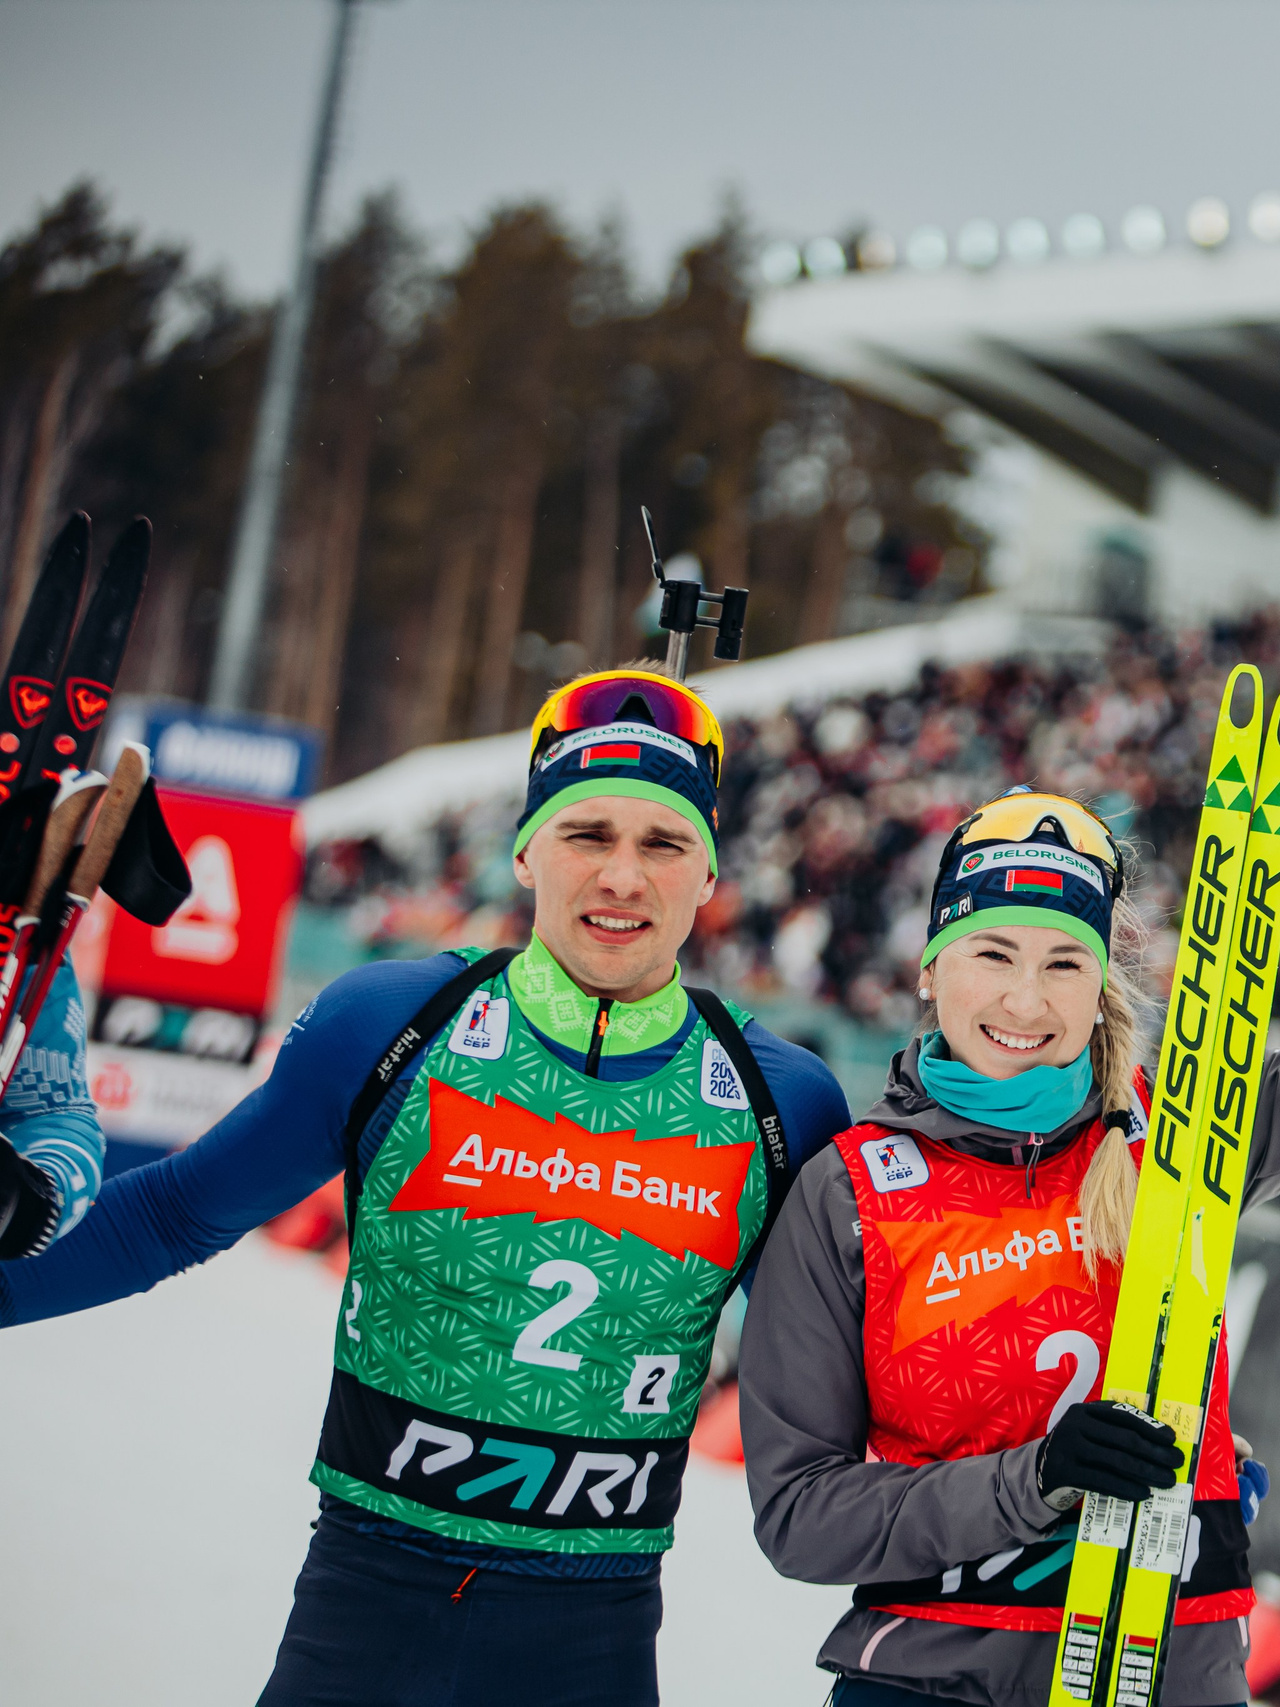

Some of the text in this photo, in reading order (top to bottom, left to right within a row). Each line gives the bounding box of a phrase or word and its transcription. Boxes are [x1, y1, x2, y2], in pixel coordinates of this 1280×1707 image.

[572, 726, 693, 756] BELORUSNEFT
[992, 849, 1101, 883] BELORUSNEFT
[939, 895, 971, 925] PARI
[1154, 834, 1235, 1182] FISCHER
[463, 1038, 490, 1049] СБР
[762, 1114, 786, 1170] biatar
[448, 1133, 722, 1218] Альфа Банк
[886, 1169, 914, 1182] СБР
[926, 1228, 1063, 1289] Альфа
[512, 1259, 600, 1371] 2
[638, 1367, 666, 1405] 2
[1035, 1329, 1100, 1434] 2
[385, 1418, 659, 1518] PARI
